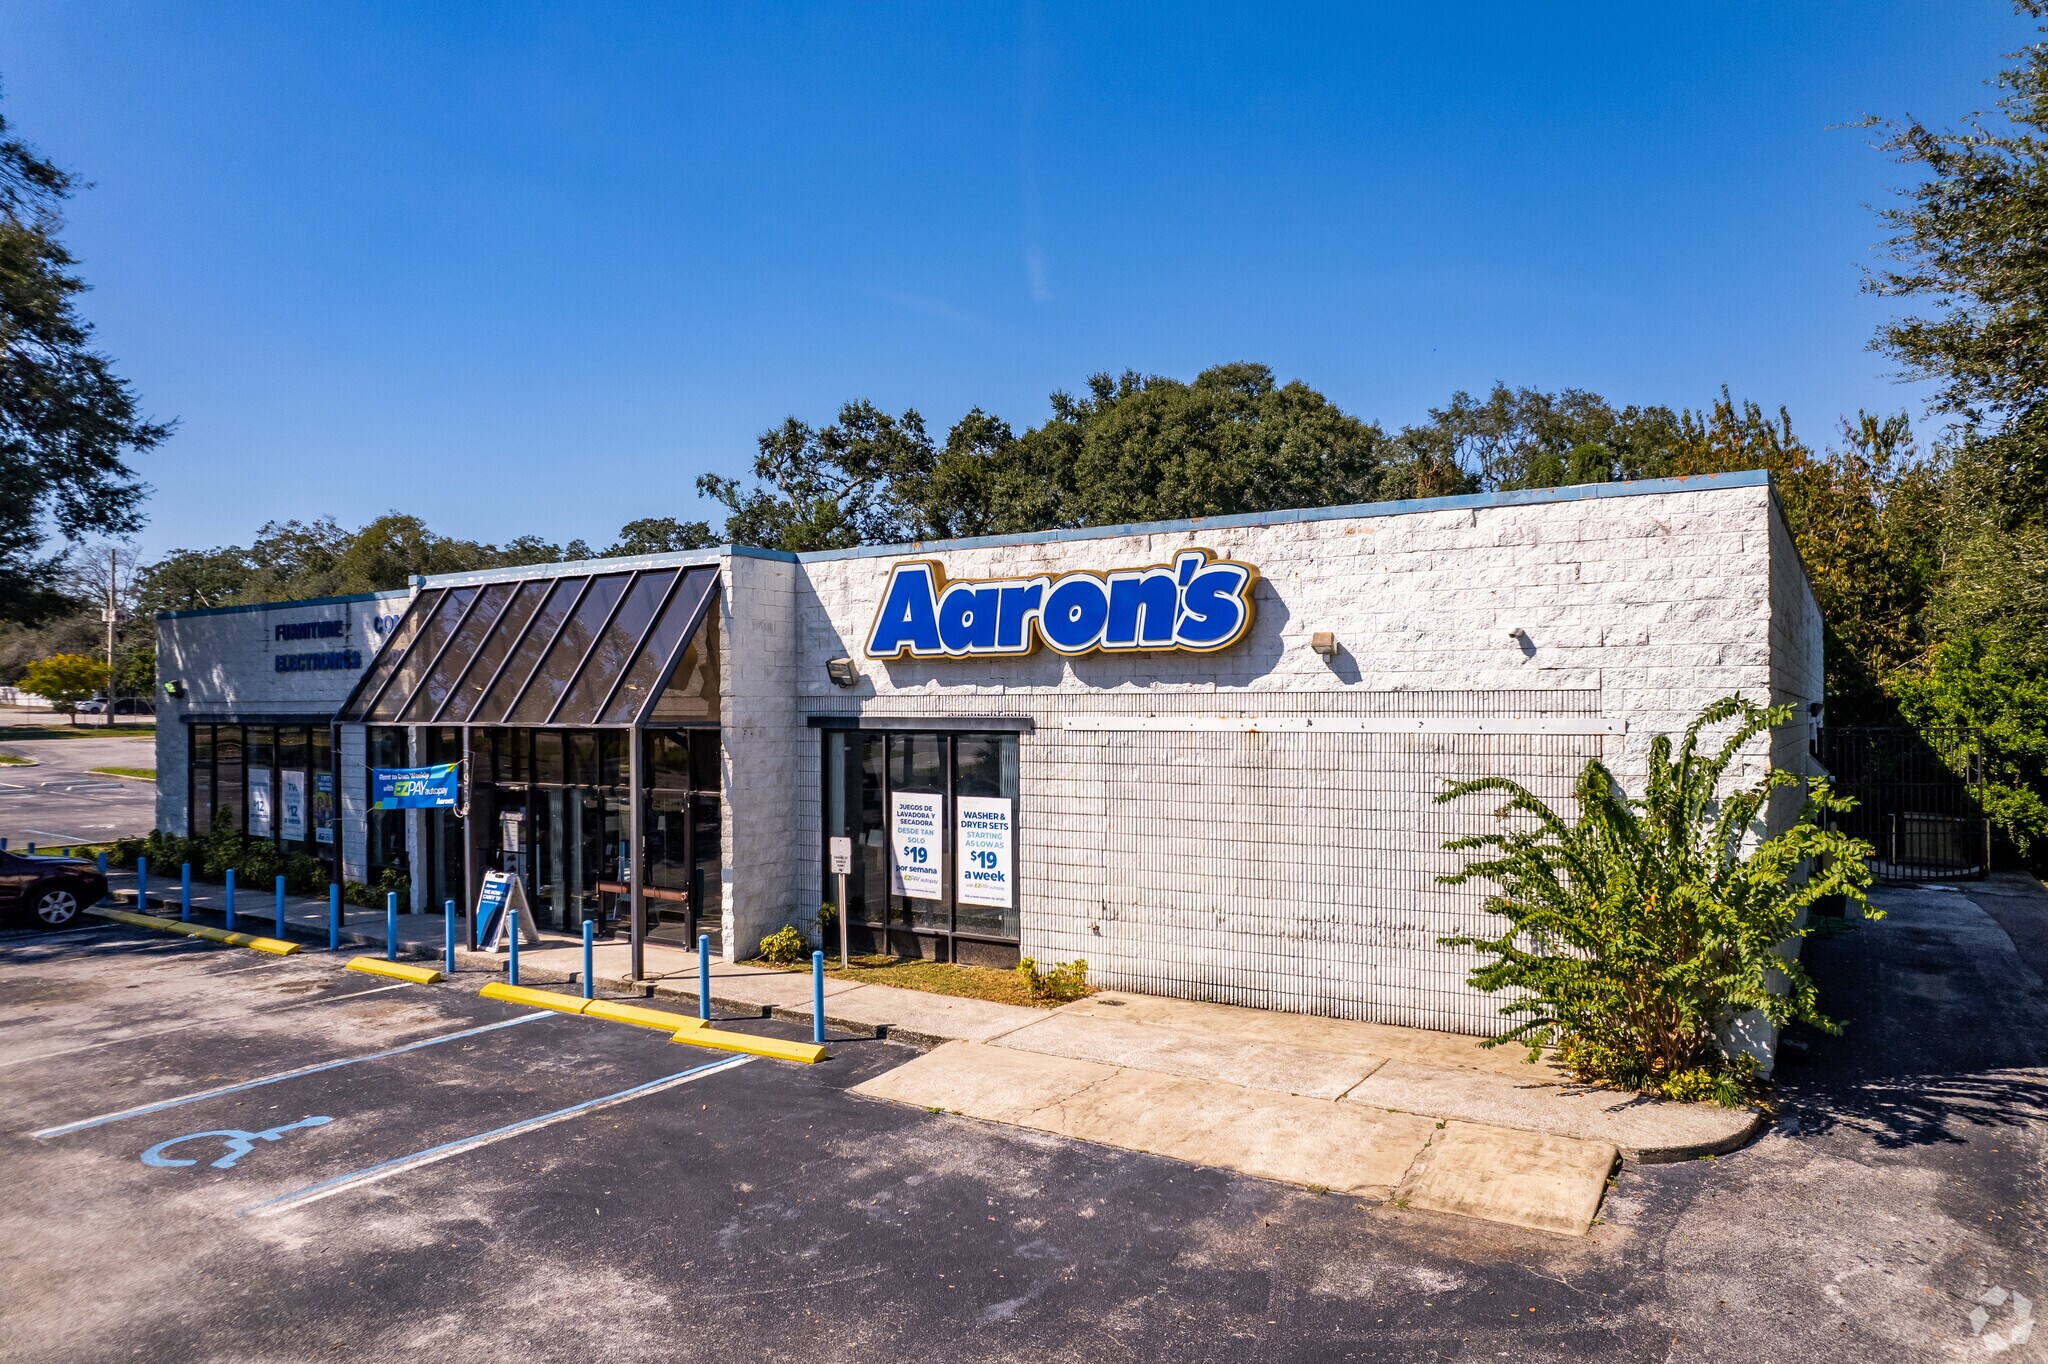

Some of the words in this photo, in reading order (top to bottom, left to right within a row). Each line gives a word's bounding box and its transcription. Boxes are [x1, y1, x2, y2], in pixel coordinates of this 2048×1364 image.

[866, 552, 1250, 657] Aaron's
[275, 620, 344, 641] FURNITURE
[275, 649, 362, 673] ELECTRONICS
[425, 787, 448, 796] autopay
[897, 811, 930, 819] LAVADORA
[963, 811, 999, 820] WASHER
[1000, 813, 1006, 821] &
[900, 818, 933, 826] SECADORA
[961, 820, 988, 829] DRYER
[989, 822, 1009, 830] SETS
[897, 827, 919, 835] DESDE
[966, 831, 1003, 840] STARTING
[903, 846, 928, 863] $19
[970, 850, 997, 869] $19
[895, 864, 908, 873] por
[909, 866, 937, 875] semana
[964, 870, 972, 880] a
[972, 870, 1006, 882] week
